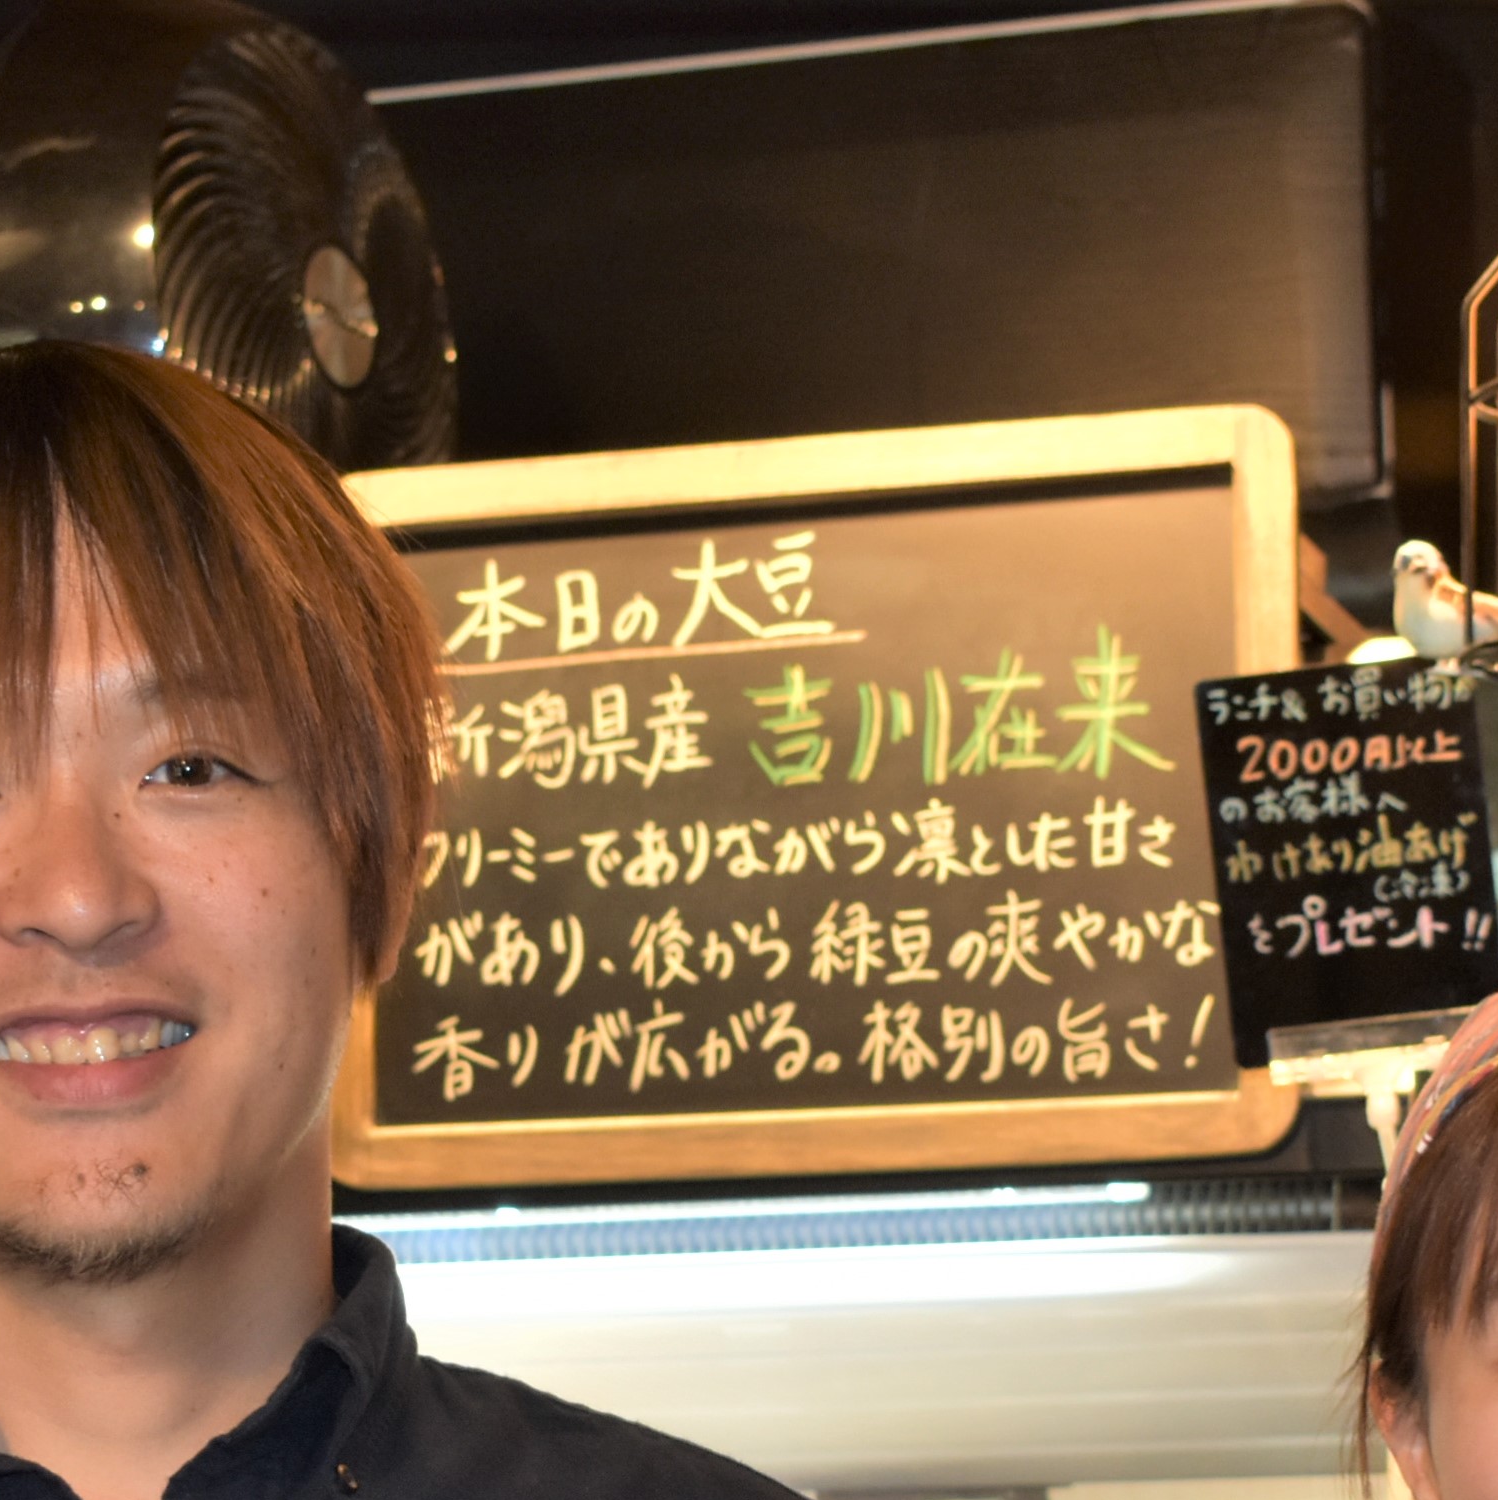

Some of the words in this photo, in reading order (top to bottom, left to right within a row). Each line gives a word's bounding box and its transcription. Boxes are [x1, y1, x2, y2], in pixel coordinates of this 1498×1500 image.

[443, 531, 835, 660] 本日の大豆
[743, 623, 1177, 786] 吉川在来
[1236, 729, 1463, 783] 2000円以上
[1219, 770, 1408, 823] のお客様へ
[415, 890, 1221, 998] があり、後から緑豆の爽やかな
